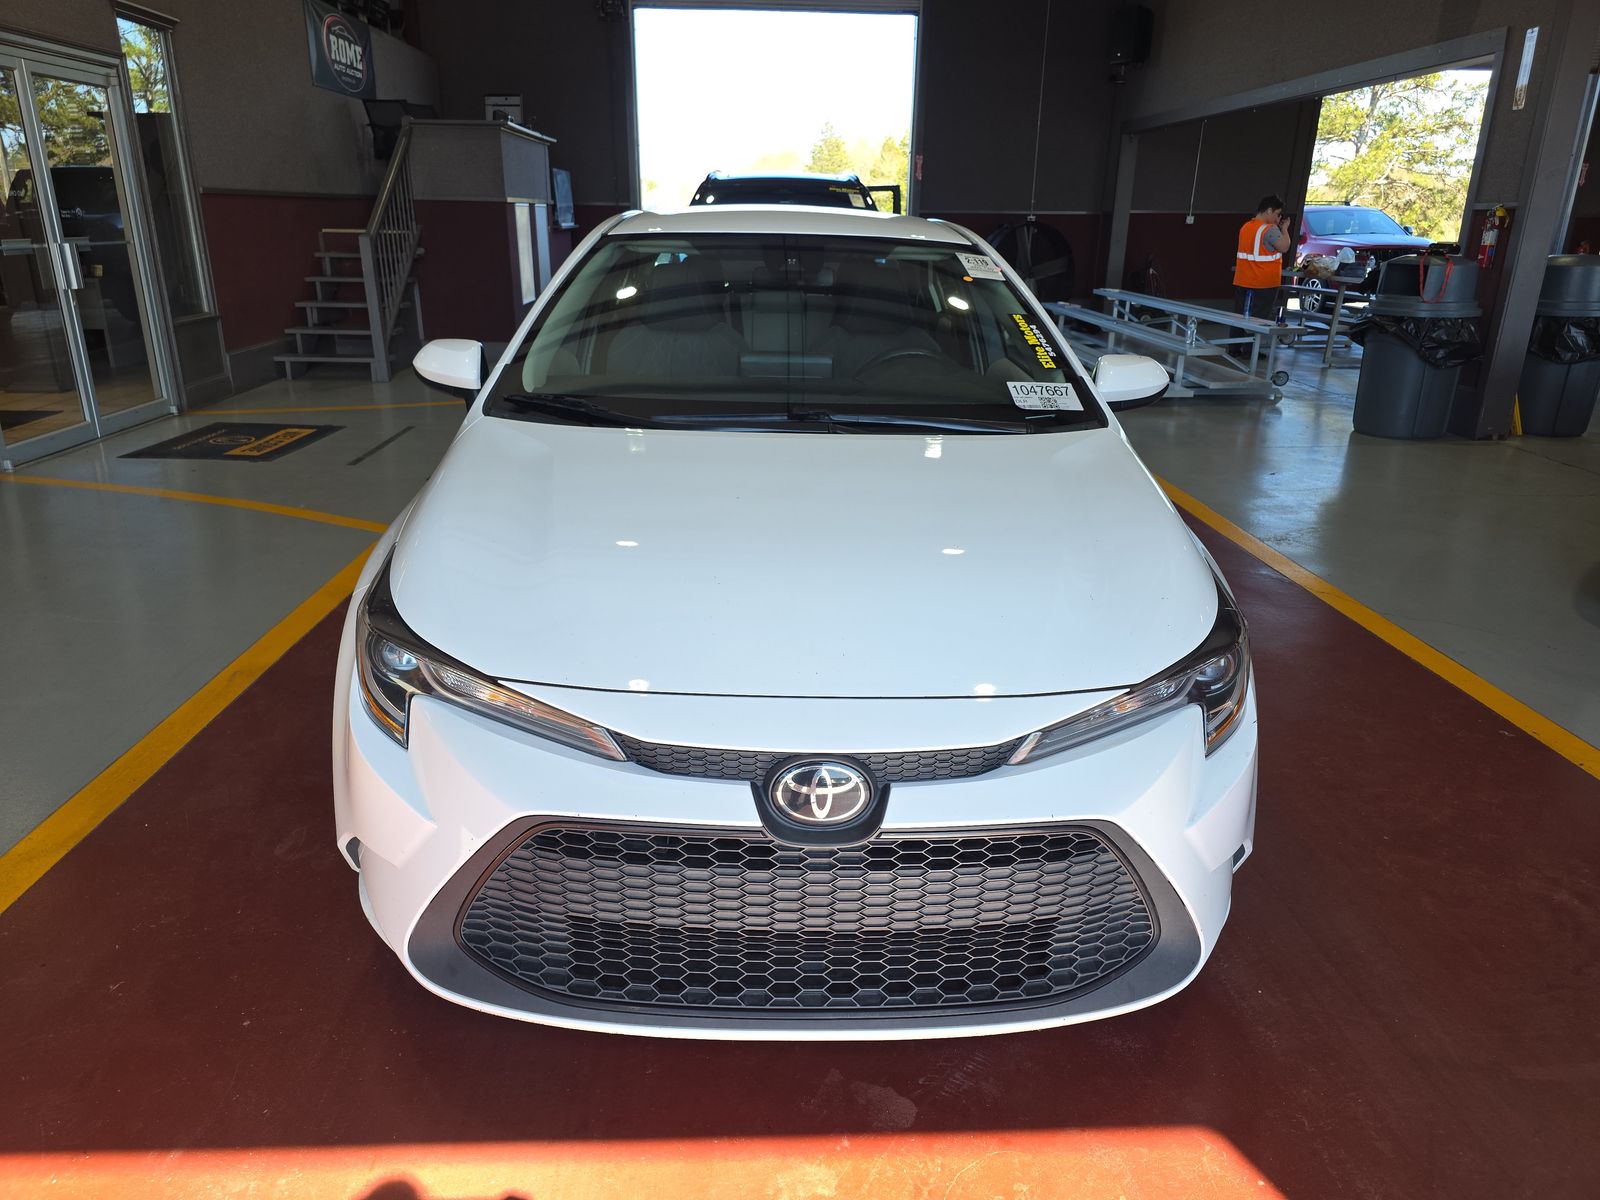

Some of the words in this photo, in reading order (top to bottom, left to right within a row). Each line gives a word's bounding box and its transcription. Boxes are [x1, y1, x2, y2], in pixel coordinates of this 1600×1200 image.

[329, 34, 362, 69] ROME
[1012, 314, 1041, 345] Motors
[1035, 346, 1057, 369] Elite
[1012, 384, 1069, 397] 1047667
